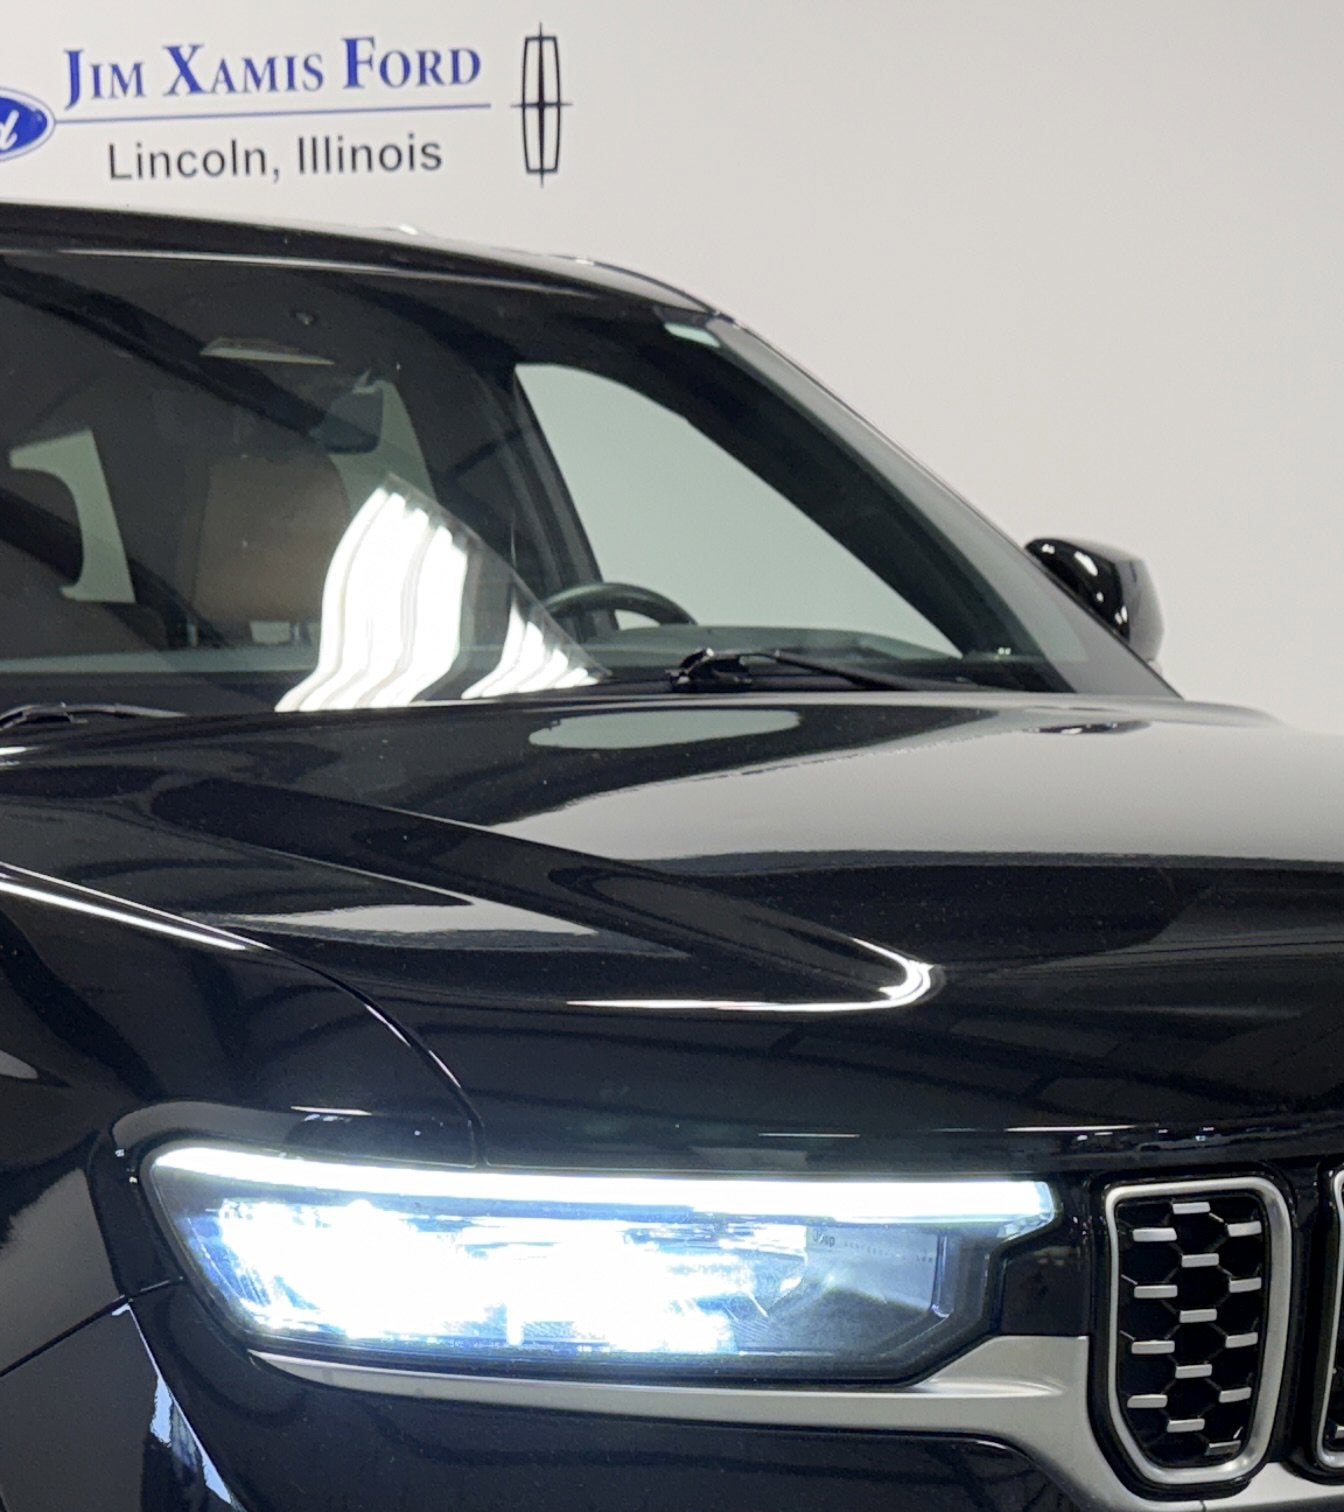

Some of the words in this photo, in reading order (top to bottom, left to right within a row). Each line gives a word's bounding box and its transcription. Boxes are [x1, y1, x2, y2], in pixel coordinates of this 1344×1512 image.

[162, 43, 324, 96] XAMIS
[341, 36, 482, 90] FORD
[108, 138, 281, 182] Lincoln,
[297, 132, 443, 174] Illinois
